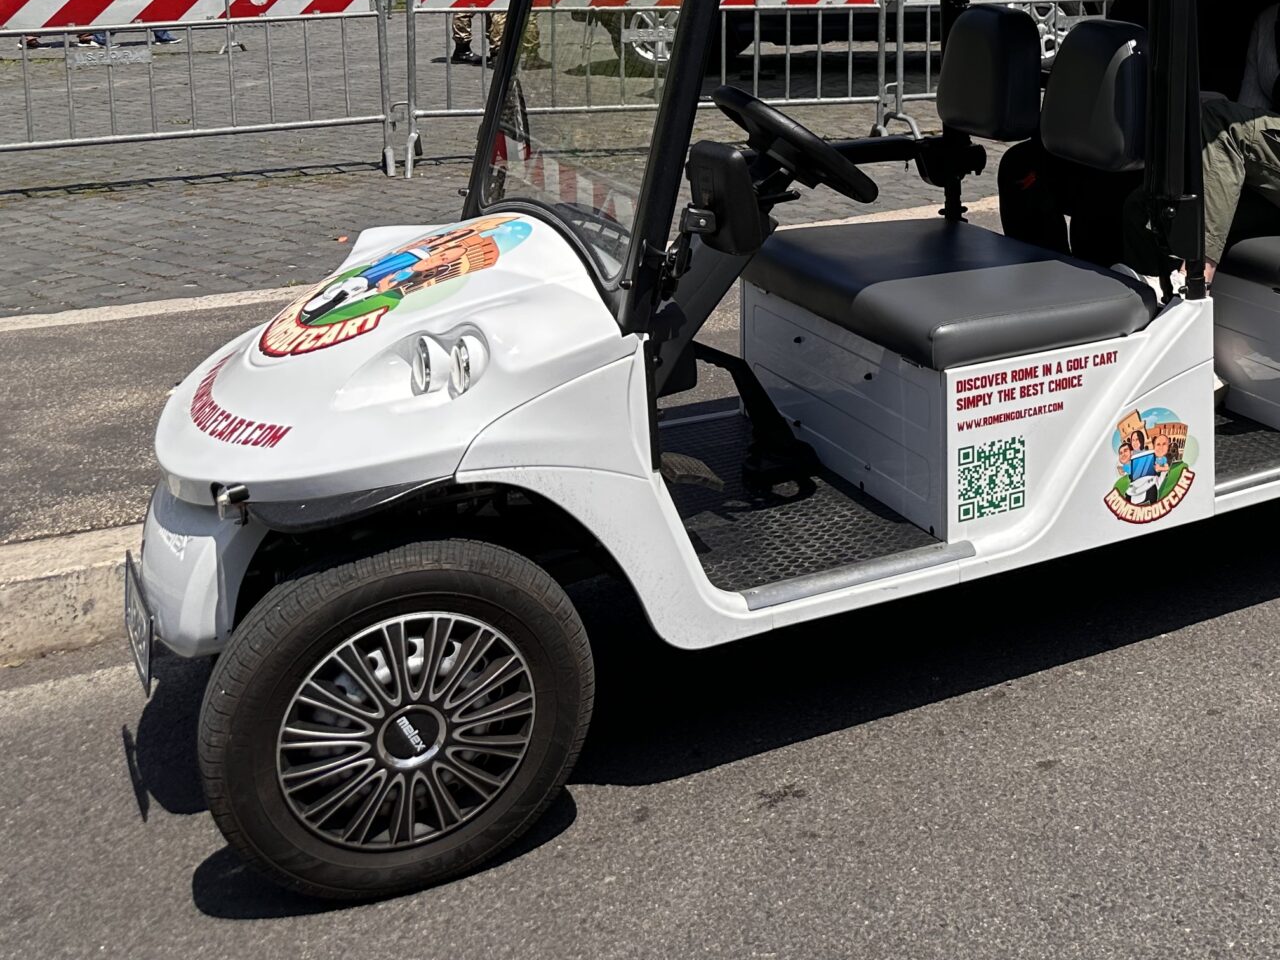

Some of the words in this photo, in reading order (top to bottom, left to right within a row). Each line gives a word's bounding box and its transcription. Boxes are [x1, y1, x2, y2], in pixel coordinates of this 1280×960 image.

[956, 372, 1007, 394] DISCOVER
[1010, 365, 1039, 383] ROME
[1042, 363, 1052, 376] IN
[1056, 361, 1063, 375] A
[1066, 356, 1090, 372] GOLF
[1092, 350, 1119, 367] CART
[956, 393, 993, 411] SIMPLY
[998, 387, 1016, 403] THE
[1020, 381, 1045, 399] BEST
[1047, 374, 1083, 392] CHOICE
[957, 401, 1064, 432] WWW.ROMEINGOLFCART.COM
[1105, 469, 1195, 522] ROMEINGOLFCART
